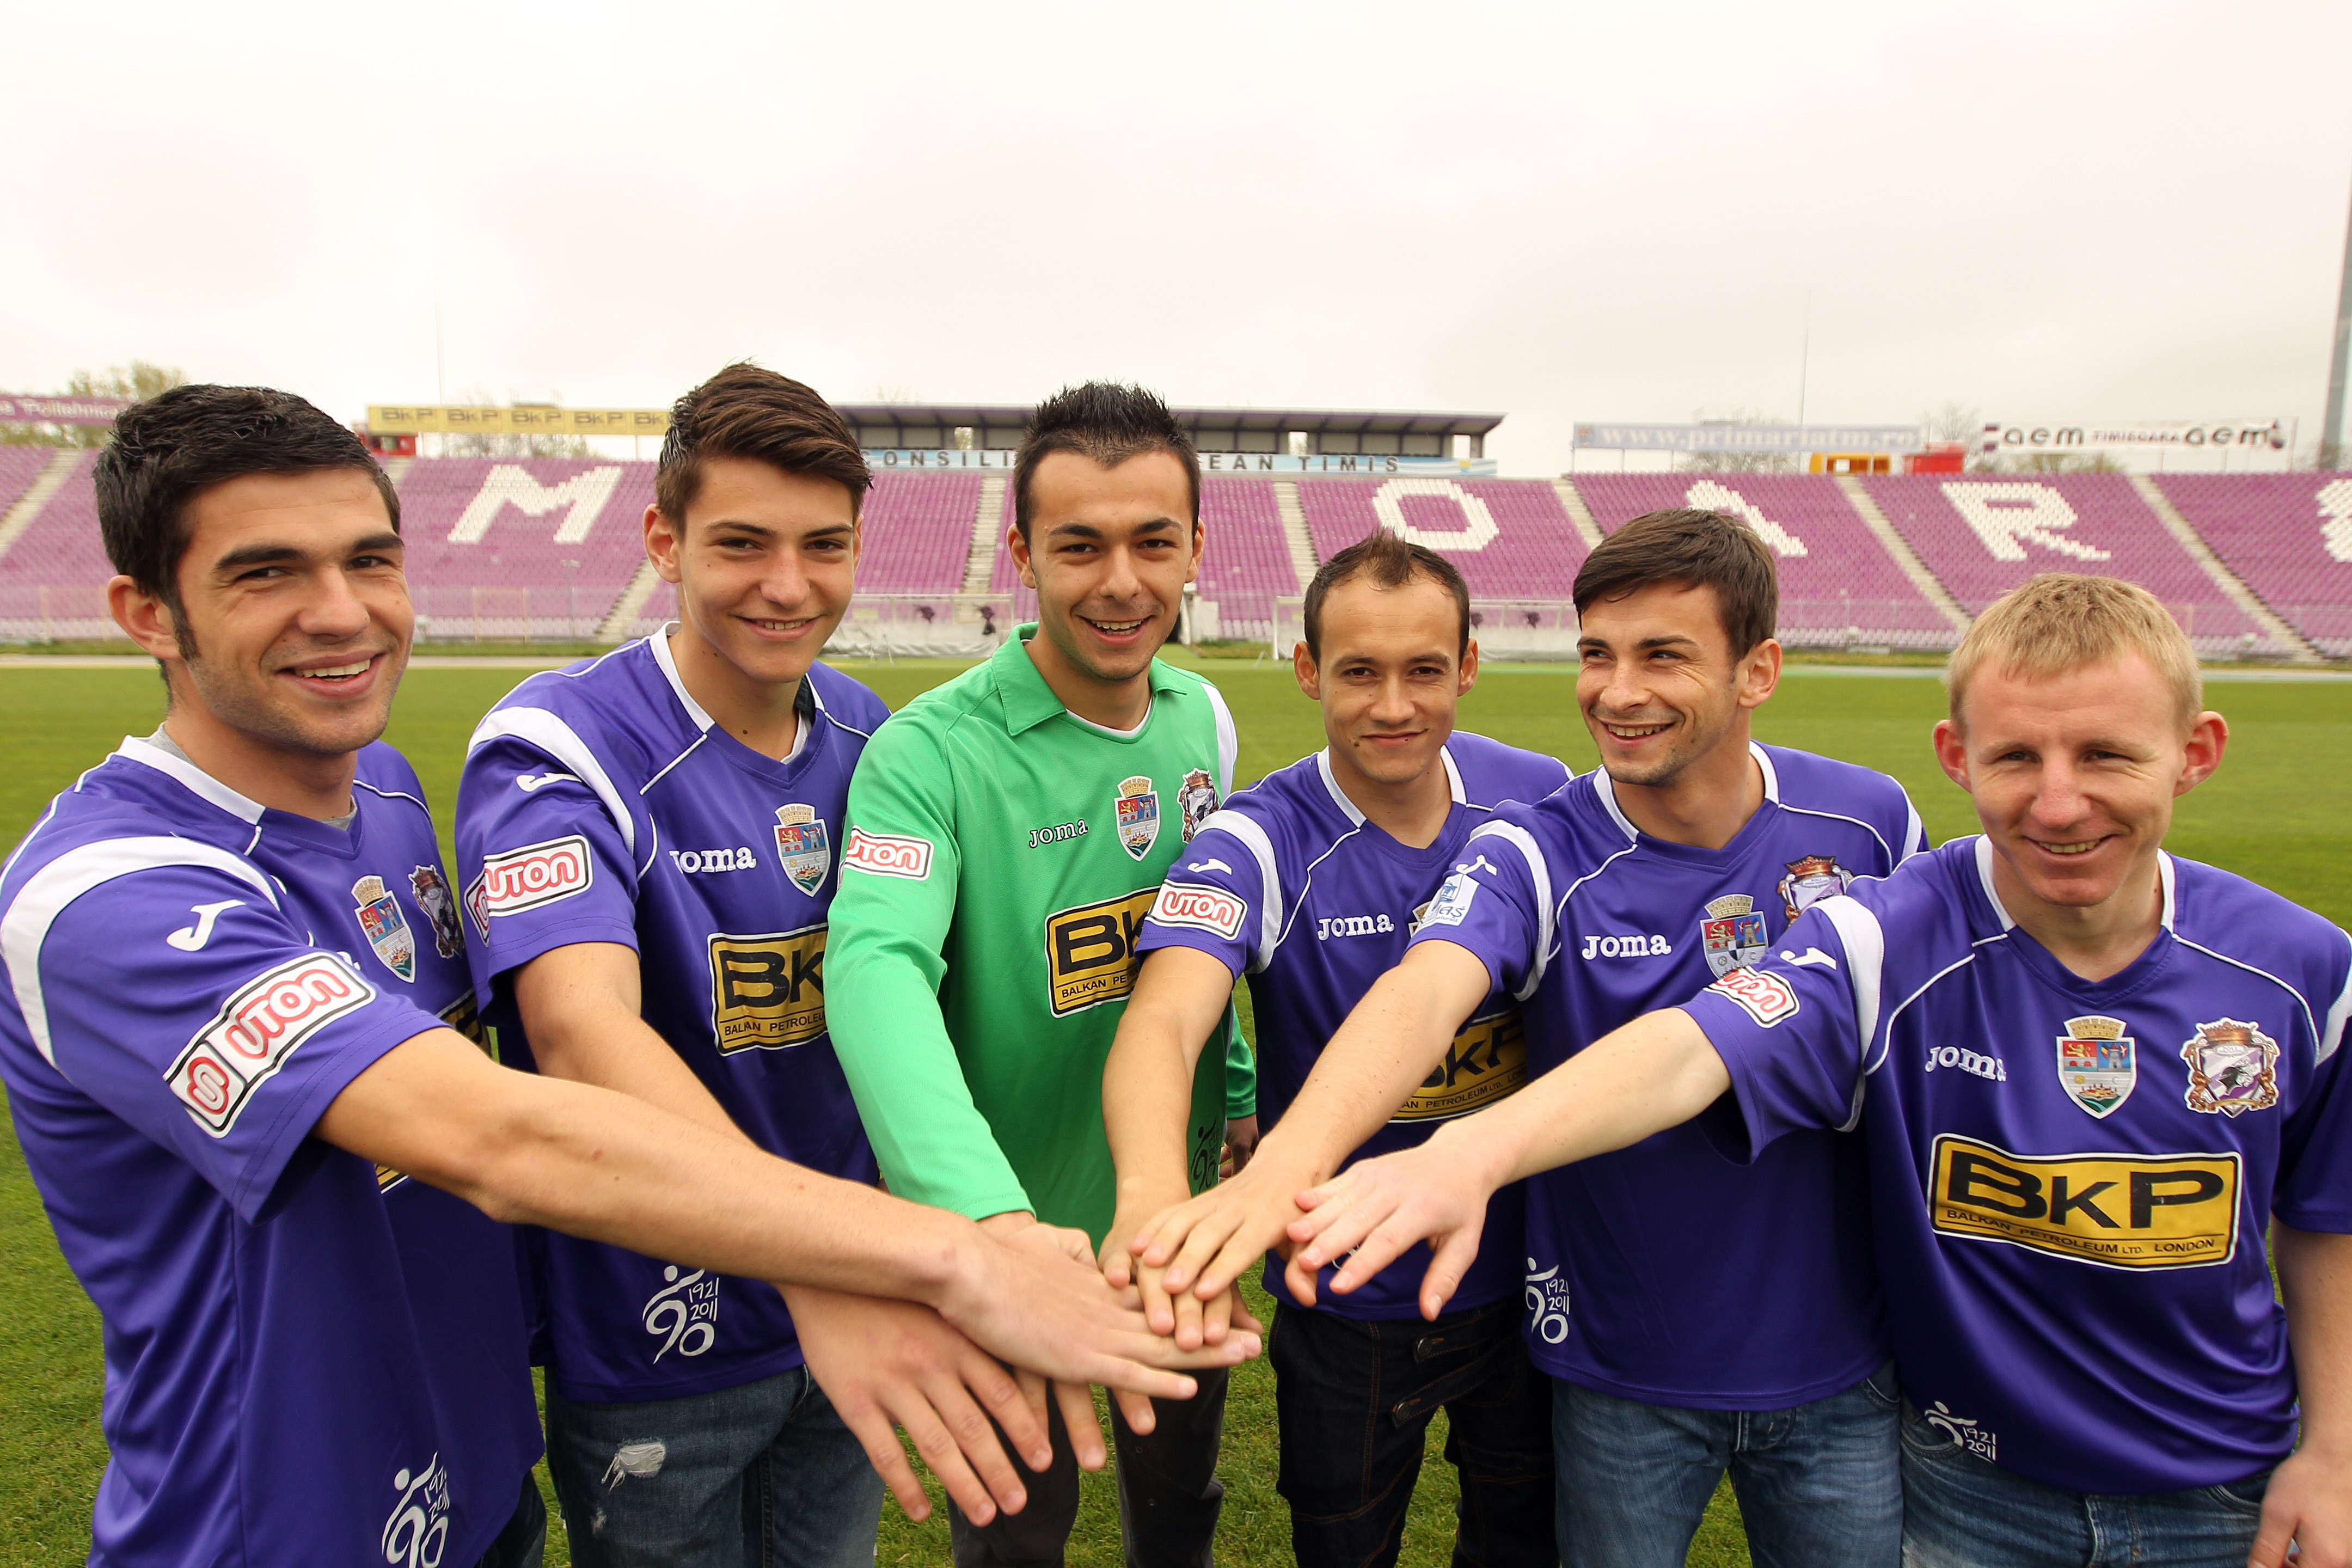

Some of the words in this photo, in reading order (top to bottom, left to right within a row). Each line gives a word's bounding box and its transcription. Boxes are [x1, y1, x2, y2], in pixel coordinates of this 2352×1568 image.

[634, 412, 669, 425] BK
[1062, 979, 1106, 998] BALKAN
[1425, 1086, 1488, 1108] PETROLEUM
[1947, 1149, 2224, 1229] BKP
[1947, 1209, 2012, 1231] BALKAN
[2020, 1228, 2118, 1253] PETROLEUM
[2154, 1239, 2214, 1252] LONDON
[689, 1277, 719, 1303] 1921
[1546, 1279, 1569, 1296] 1921
[690, 1298, 718, 1322] 2011
[1548, 1296, 1569, 1315] 2011
[1963, 1426, 1996, 1445] 1921
[1967, 1440, 1996, 1461] 2011
